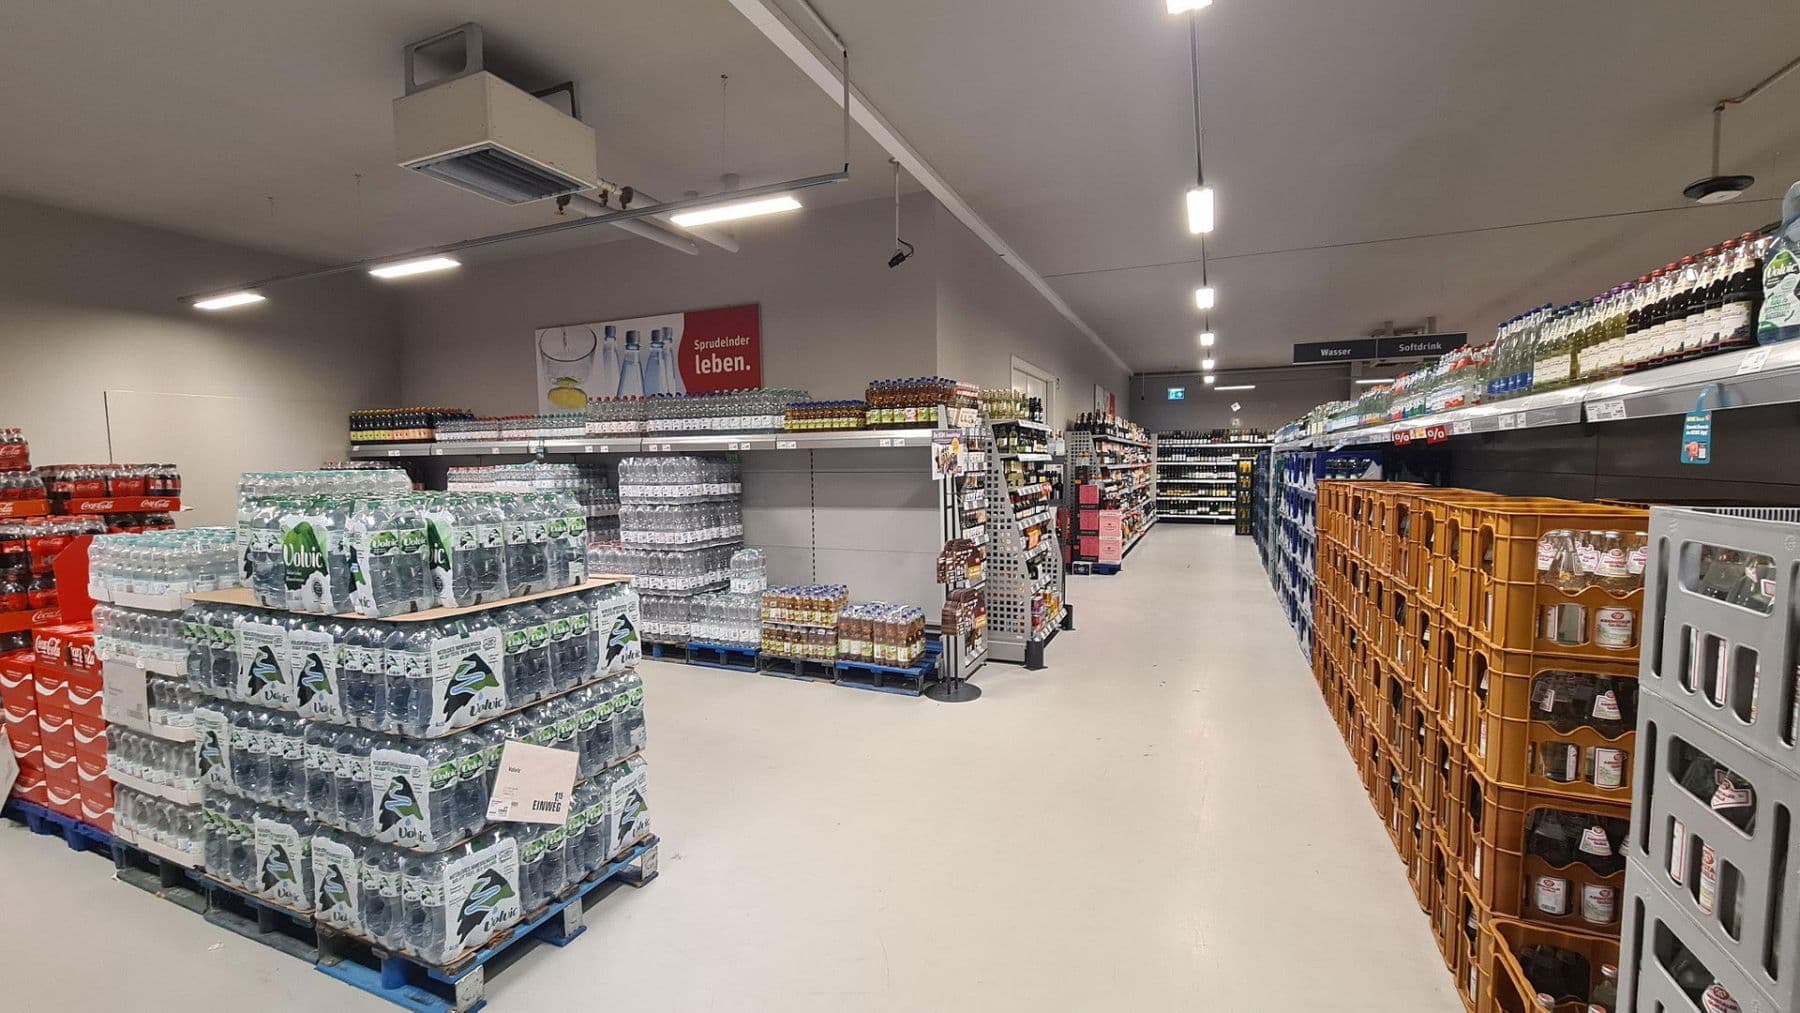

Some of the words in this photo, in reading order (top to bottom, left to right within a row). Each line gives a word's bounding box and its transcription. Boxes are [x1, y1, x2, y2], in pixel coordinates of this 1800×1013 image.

[694, 335, 751, 352] Sprudelnder
[1398, 341, 1443, 352] Softdrink
[1320, 348, 1352, 357] Wasser
[695, 353, 751, 375] leben.
[80, 501, 114, 511] Coca-Cola
[140, 499, 171, 509] Coca-Cola
[283, 544, 324, 569] Volvic
[264, 689, 290, 704] Voic
[469, 696, 504, 717] Volvic
[532, 800, 562, 813] EINWEG
[484, 907, 518, 933] Volvic
